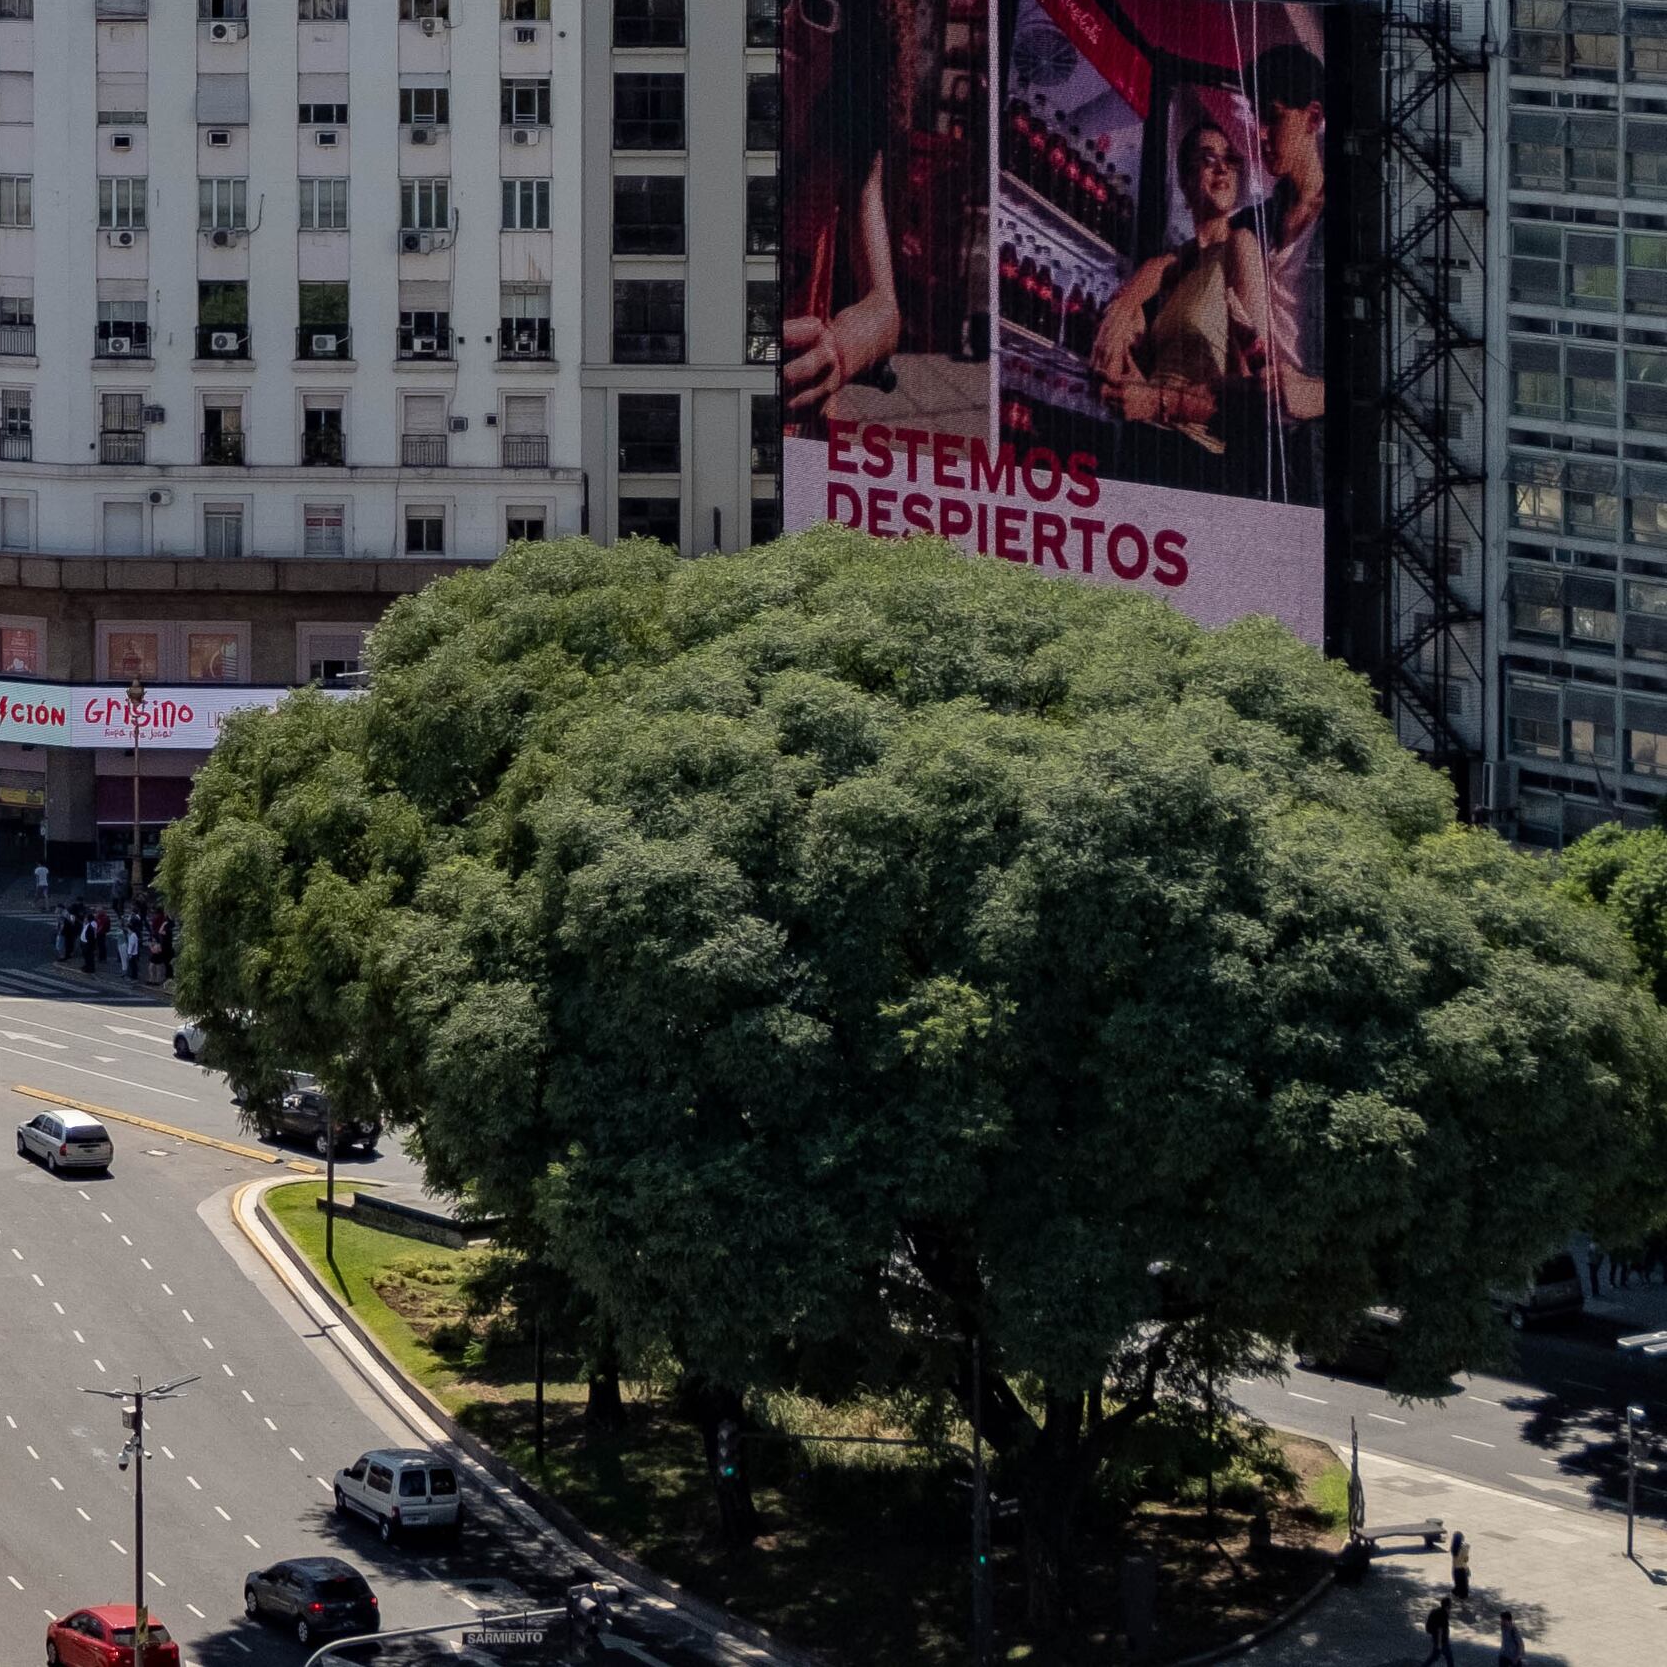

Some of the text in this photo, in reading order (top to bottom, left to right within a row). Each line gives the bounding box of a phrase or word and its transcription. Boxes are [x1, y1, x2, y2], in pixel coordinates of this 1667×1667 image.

[827, 419, 1100, 508] ESTEMOS
[827, 481, 1189, 586] DESPIERTOS
[11, 700, 66, 727] CIÓN
[84, 697, 194, 728] Grisino
[467, 1632, 543, 1645] SARMIENTO
